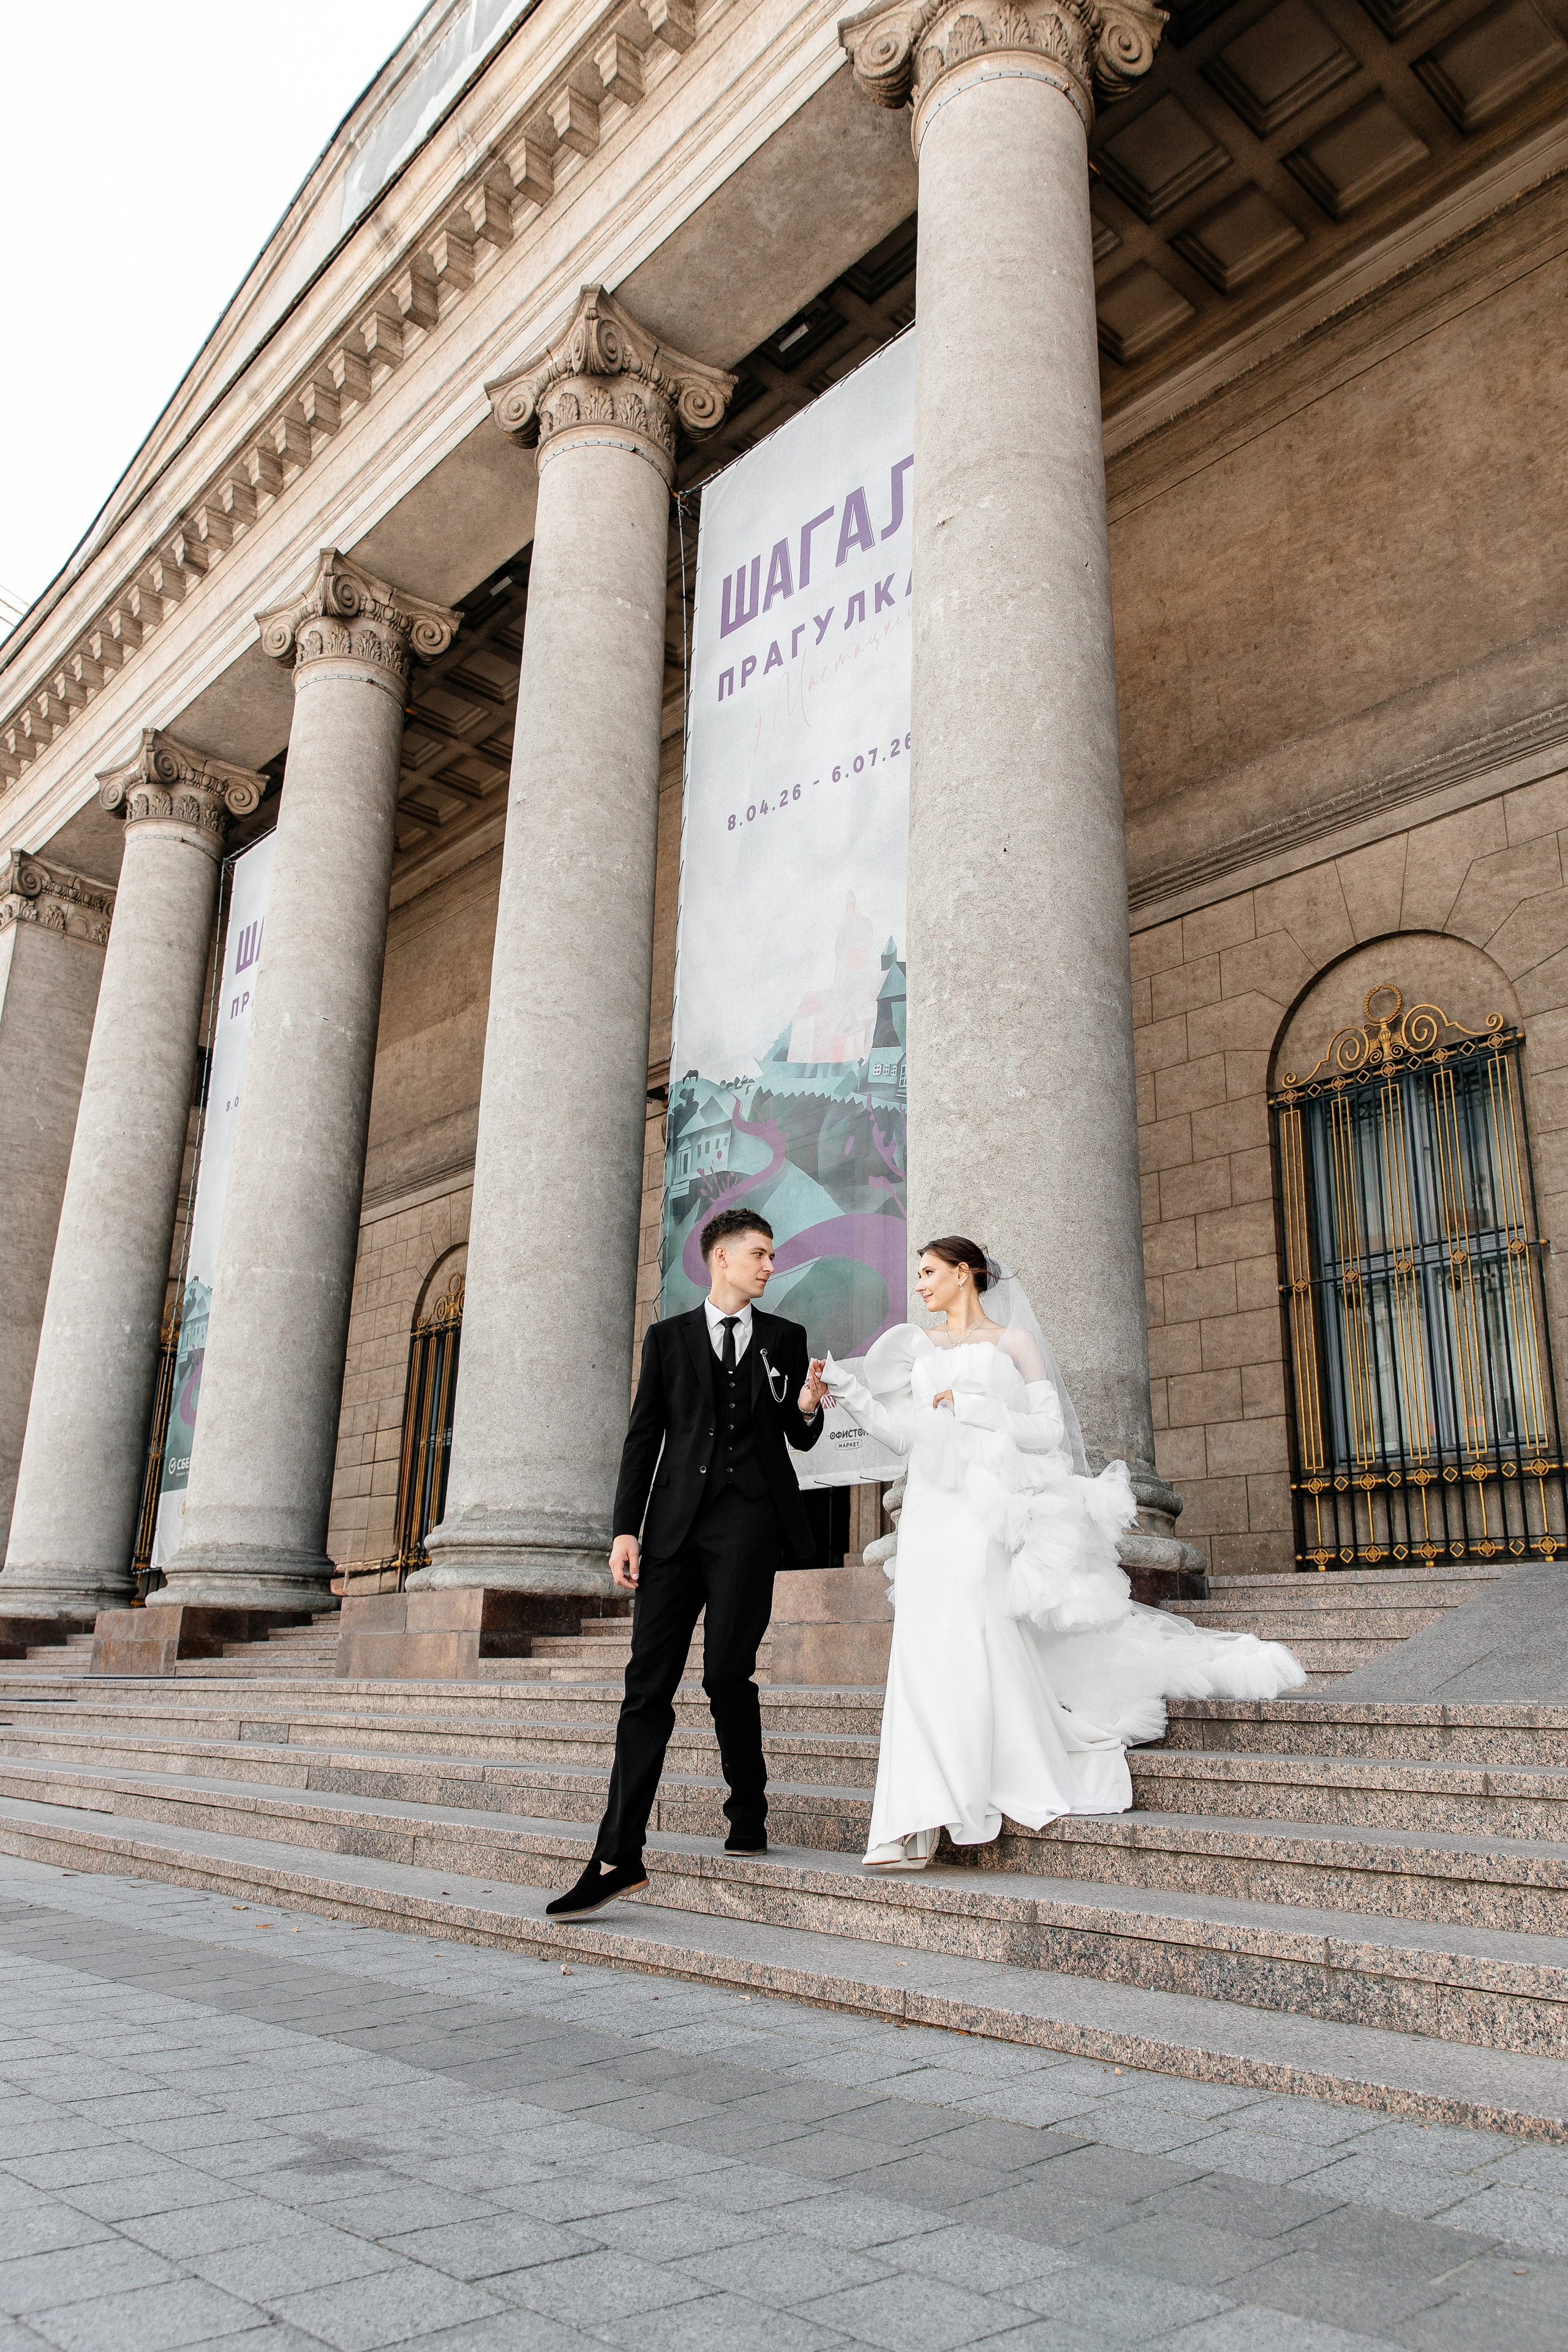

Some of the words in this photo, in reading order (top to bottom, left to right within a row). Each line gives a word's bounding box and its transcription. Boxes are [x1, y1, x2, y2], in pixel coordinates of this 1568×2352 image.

[717, 568, 913, 703] ПРАГУЛК
[727, 783, 801, 831] 8.04.26
[832, 732, 911, 783] 6.07.26
[230, 990, 254, 1020] ПР
